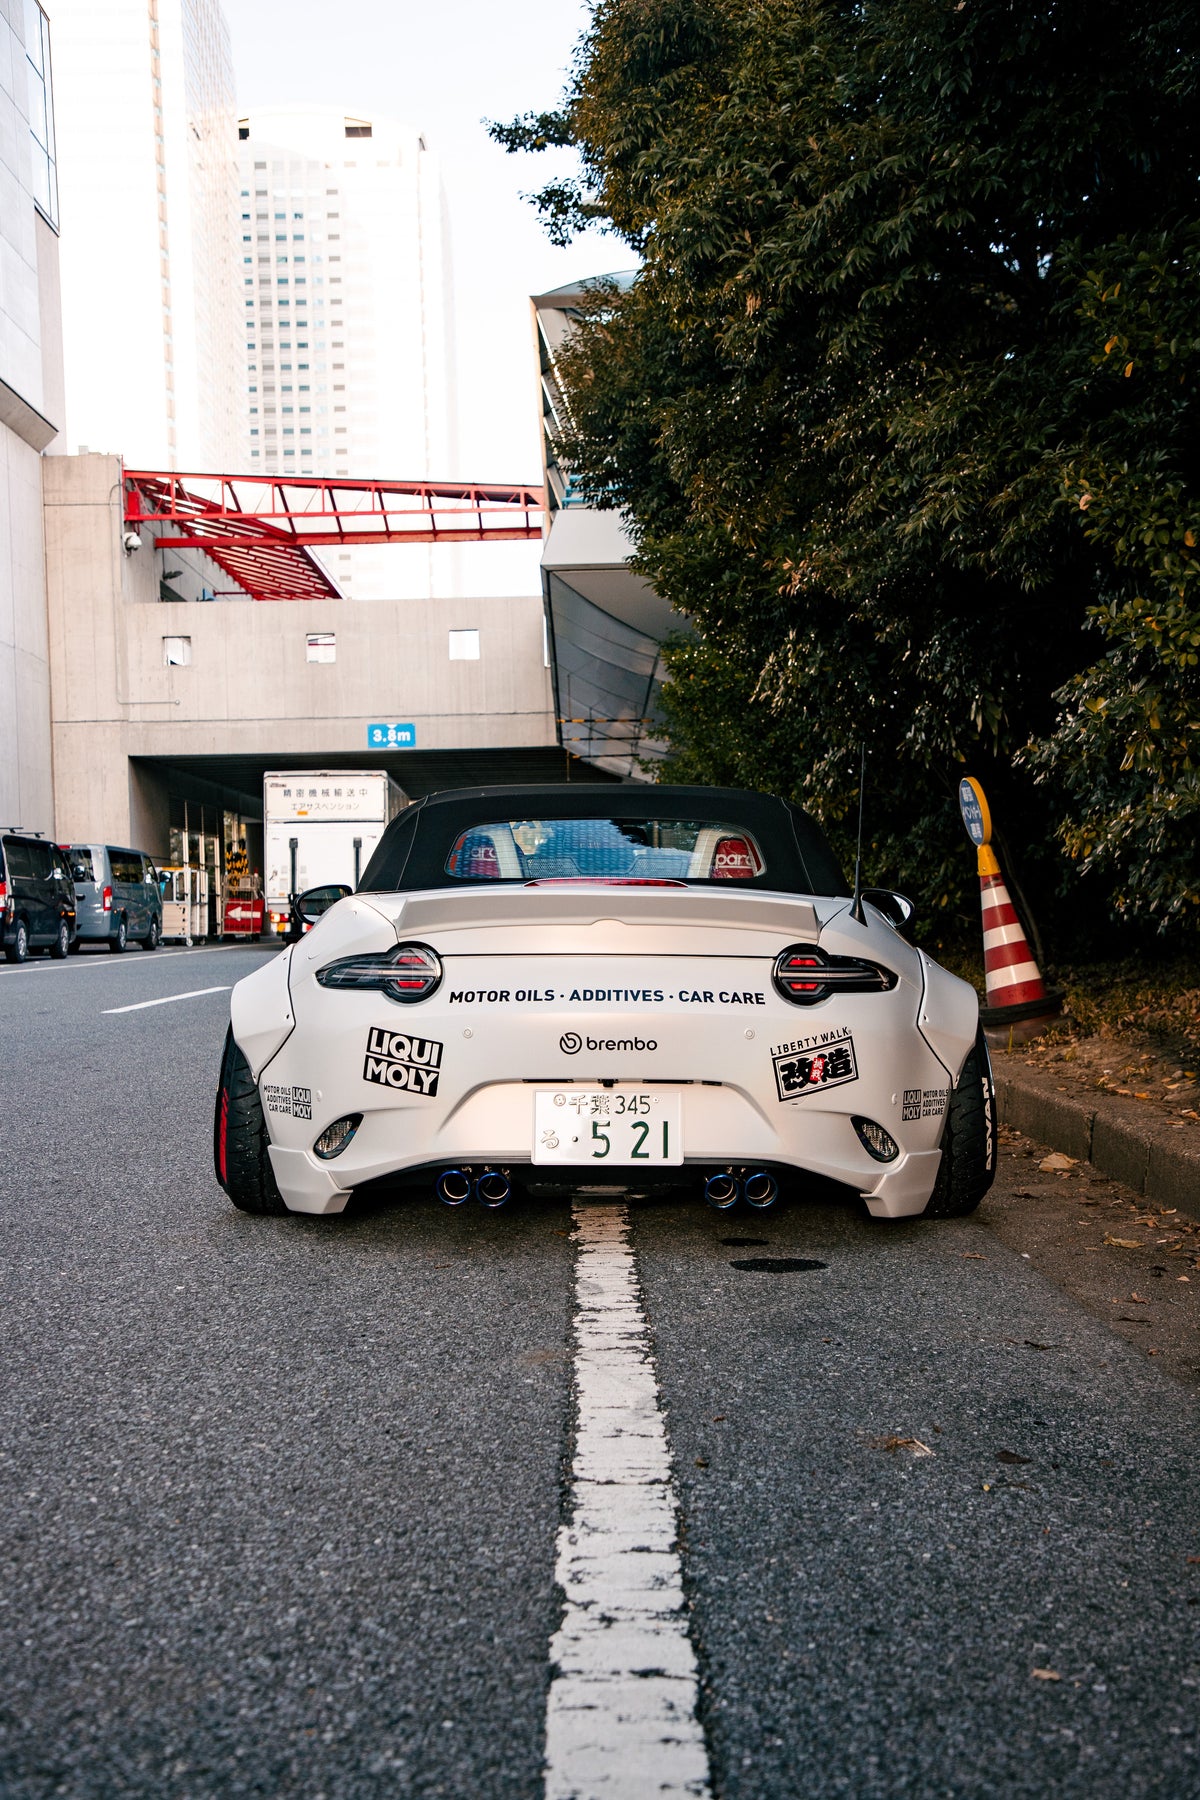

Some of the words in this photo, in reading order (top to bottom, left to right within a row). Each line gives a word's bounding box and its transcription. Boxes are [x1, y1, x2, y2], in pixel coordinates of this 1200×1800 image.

[373, 729, 411, 742] 3.8m
[283, 788, 367, 798] 精密機械輸送中
[449, 991, 511, 1003] MOTOR
[515, 990, 555, 1001] OILS
[569, 989, 664, 1001] ADDITIVES
[678, 990, 715, 1003] CAR
[719, 991, 766, 1005] CARE
[369, 1029, 440, 1067] LIQUI
[586, 1036, 658, 1051] brembo
[770, 1035, 818, 1056] LIBERTY
[820, 1026, 849, 1043] WALK
[366, 1057, 439, 1094] MOLY
[264, 1085, 280, 1095] MOTOR
[281, 1087, 291, 1096] OILS
[292, 1087, 311, 1103] LIQUI
[904, 1090, 921, 1104] LIQUI
[923, 1090, 938, 1098] MOTOR
[939, 1089, 949, 1097] OILS
[267, 1094, 291, 1105] ADDITIVES
[569, 1095, 610, 1115] 千葉
[615, 1095, 650, 1114] 345
[923, 1098, 946, 1107] ADDITIVES
[269, 1104, 278, 1112] CAR
[279, 1105, 291, 1114] CARE
[293, 1103, 312, 1119] MOLY
[903, 1106, 921, 1119] MOLY
[932, 1107, 944, 1115] CARE
[981, 1077, 993, 1171] ADVAN
[541, 1129, 559, 1149] る
